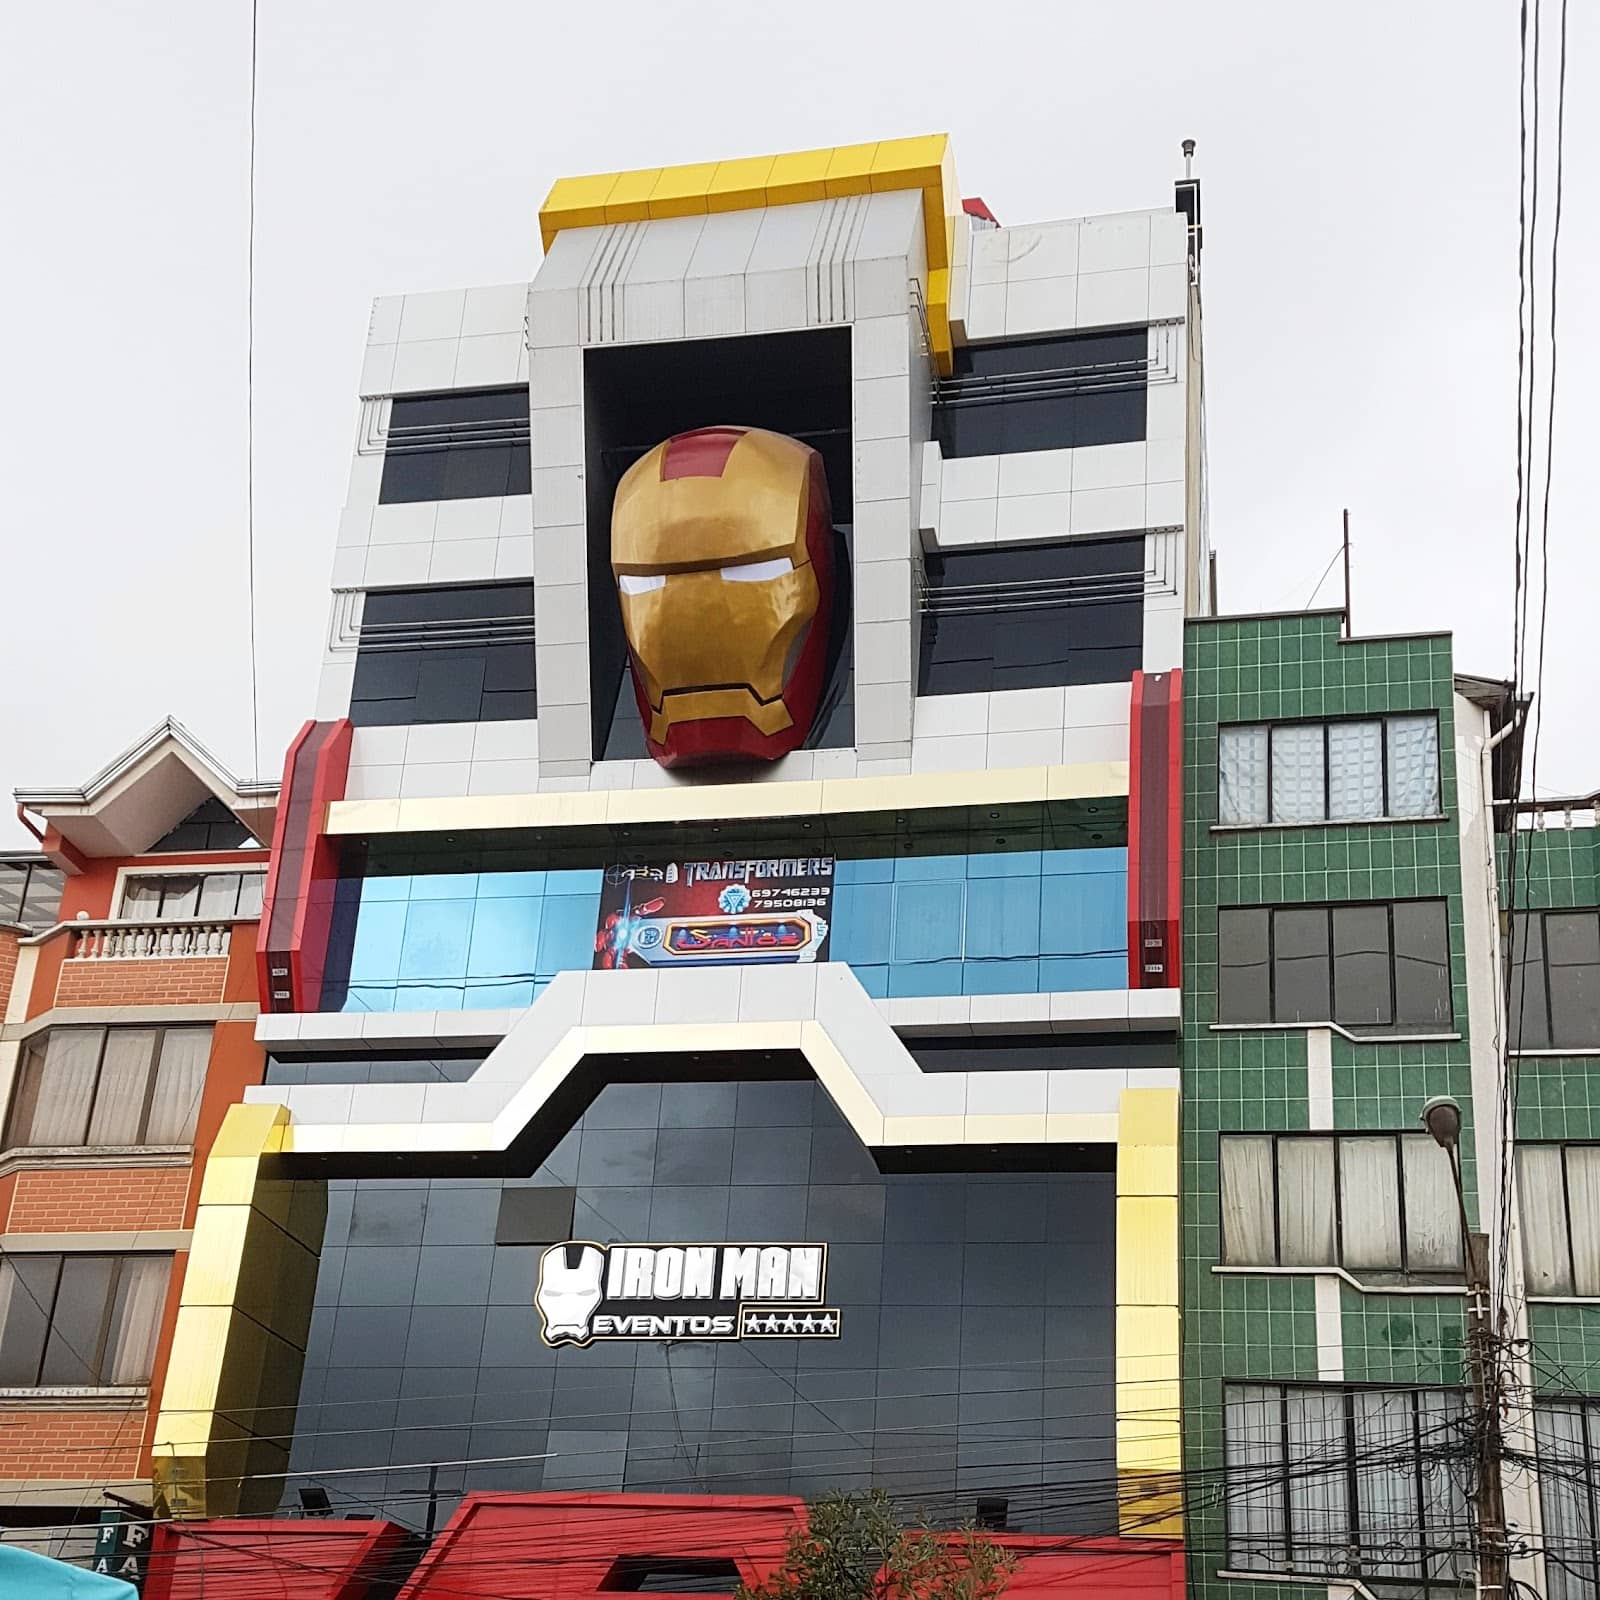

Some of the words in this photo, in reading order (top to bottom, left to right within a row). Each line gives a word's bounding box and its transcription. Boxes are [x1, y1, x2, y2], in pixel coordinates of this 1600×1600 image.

[683, 857, 833, 888] TRANSFORMERS
[606, 1246, 717, 1301] IRON
[719, 1246, 823, 1301] MAN
[592, 1314, 736, 1337] EVENTOS
